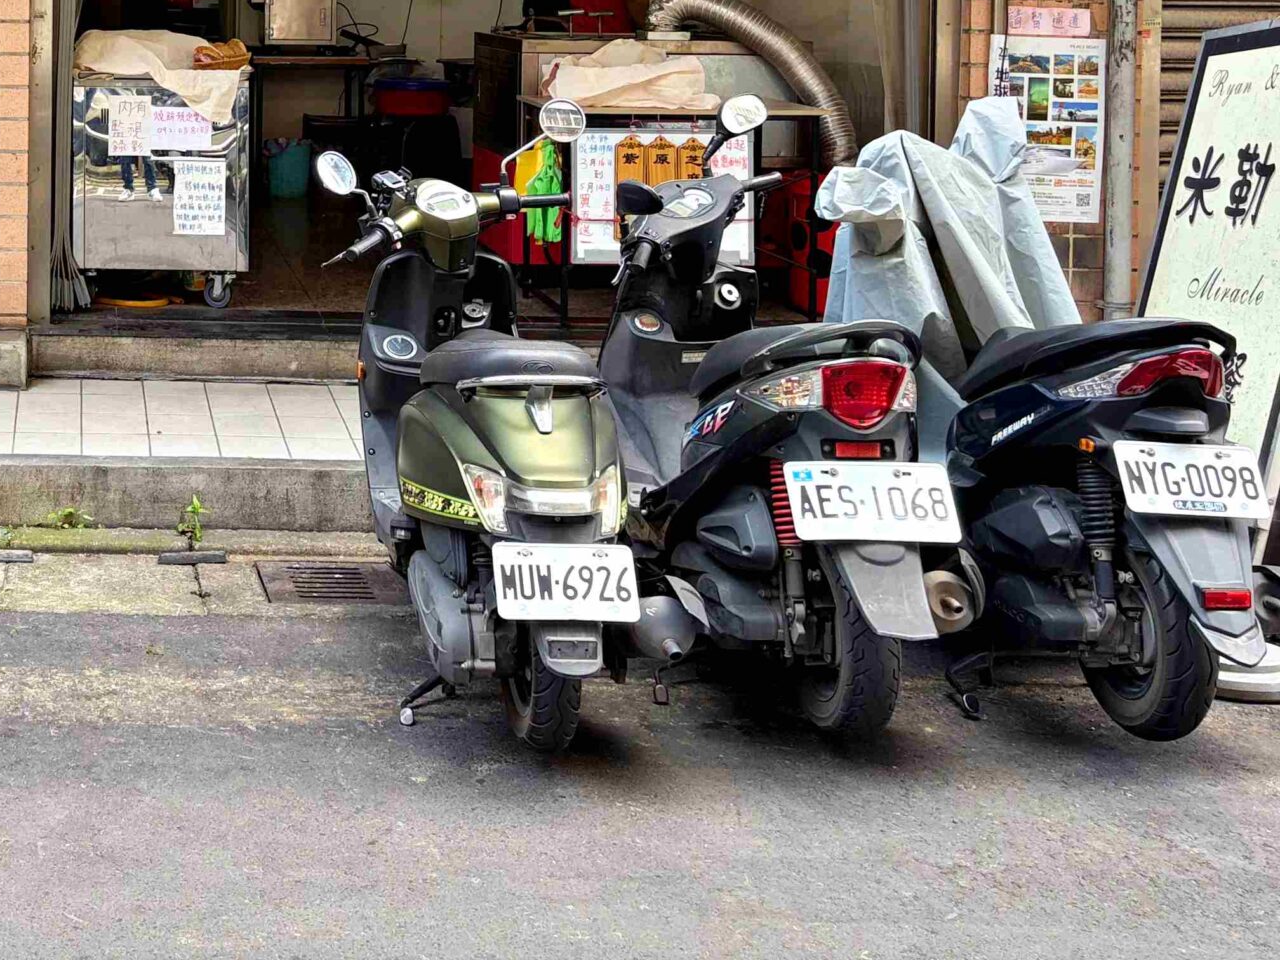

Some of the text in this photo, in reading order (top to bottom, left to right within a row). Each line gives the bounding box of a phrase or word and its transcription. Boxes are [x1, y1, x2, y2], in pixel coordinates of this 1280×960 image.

[1209, 69, 1252, 107] Ryan
[1176, 141, 1276, 229] 米勒
[1186, 267, 1265, 307] Miracle
[991, 411, 1035, 447] FREEWAY
